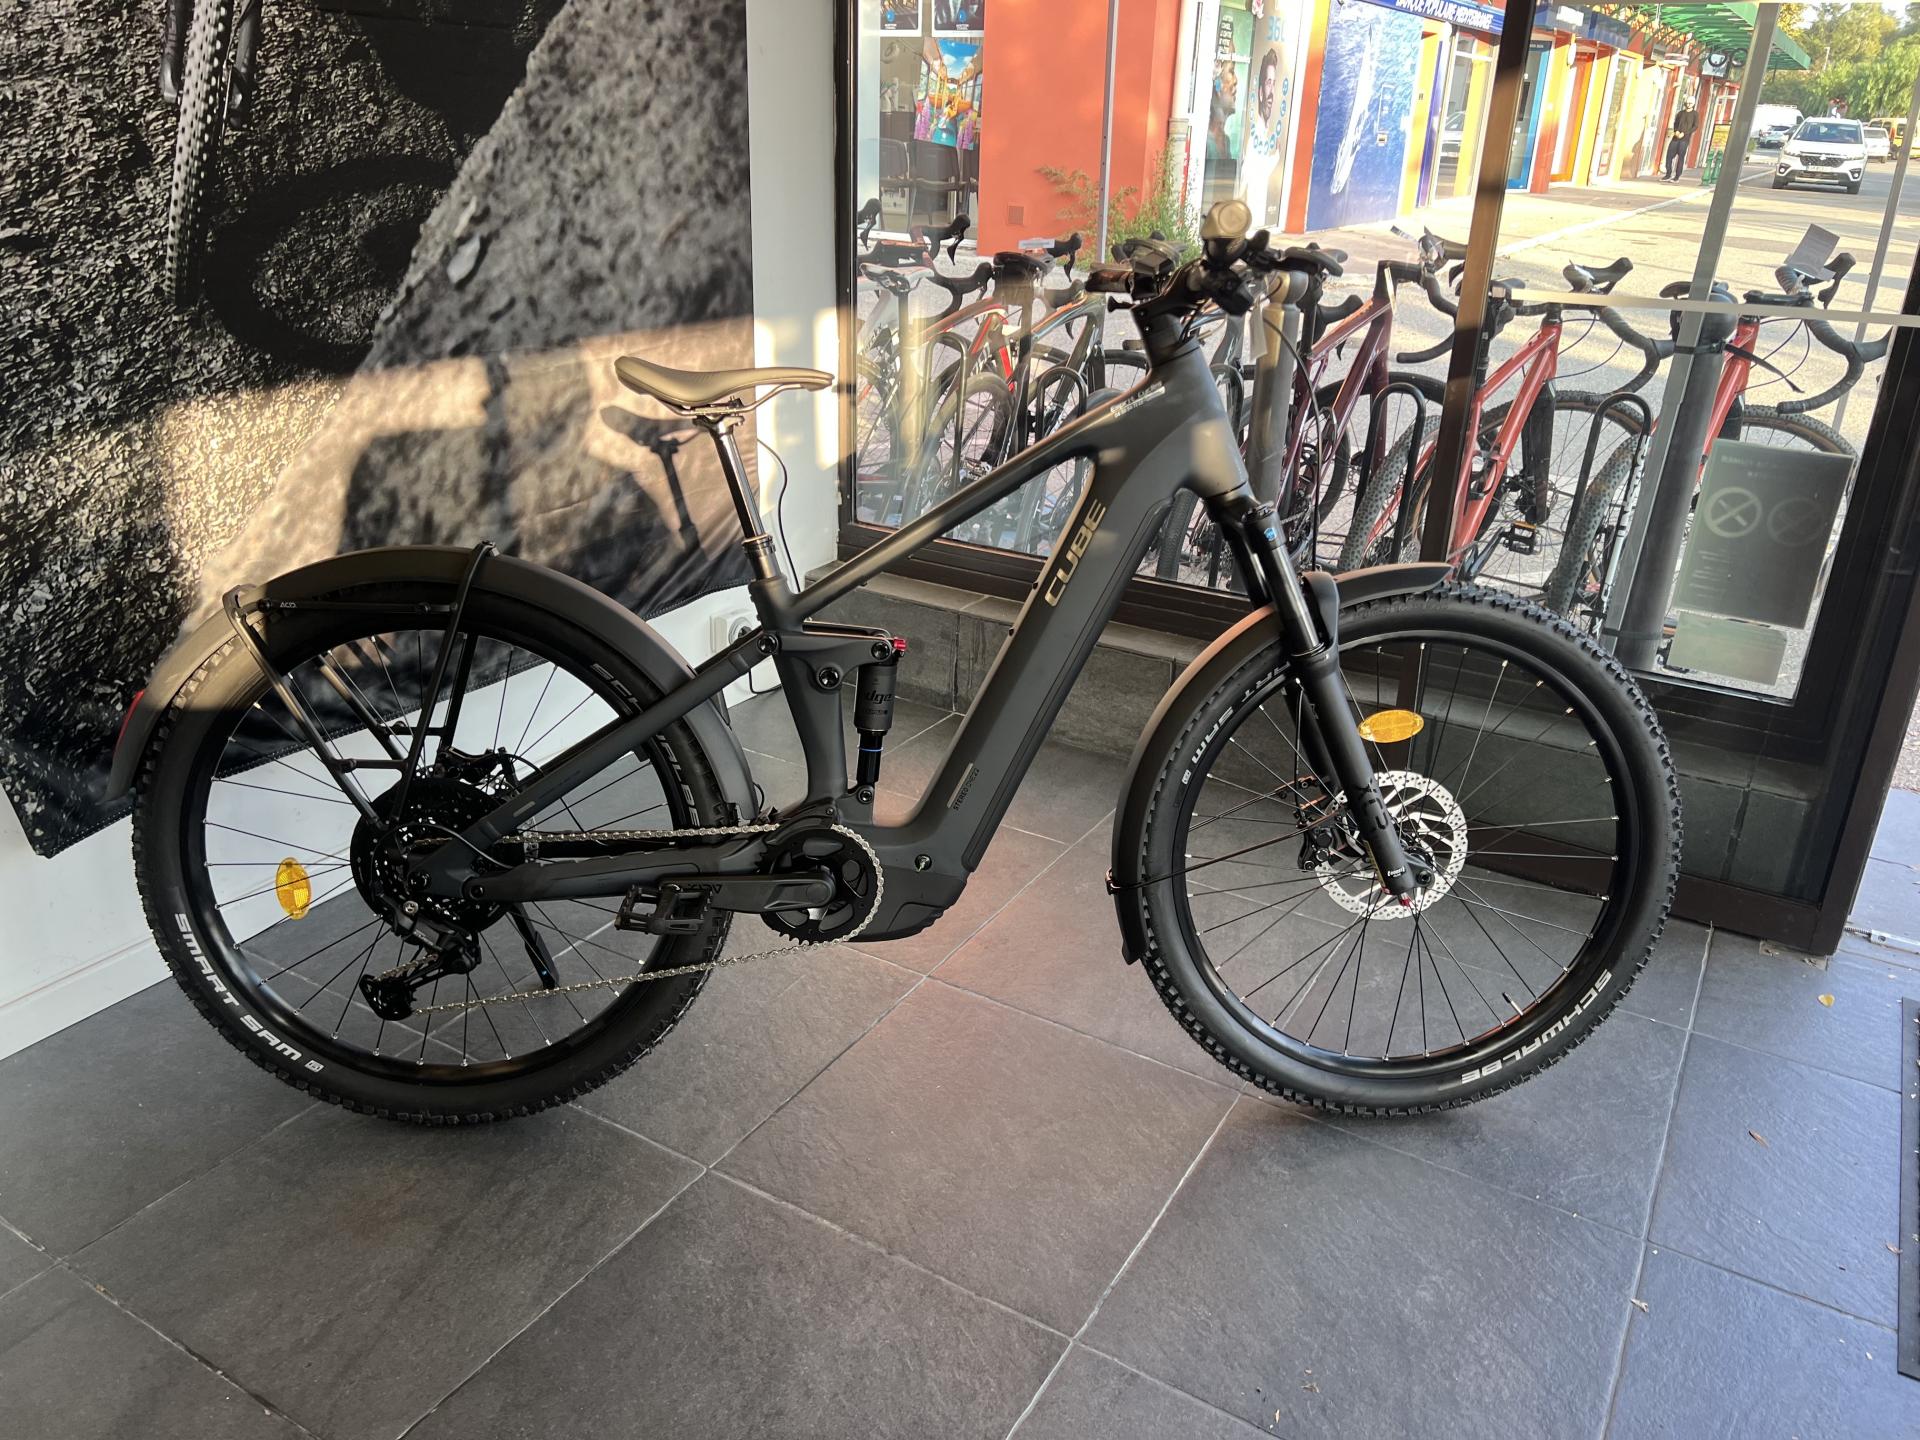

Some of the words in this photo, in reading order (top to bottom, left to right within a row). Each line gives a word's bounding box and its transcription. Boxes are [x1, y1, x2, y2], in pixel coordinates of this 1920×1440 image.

[1044, 499, 1107, 607] CUBE
[590, 663, 701, 828] SCHALBE
[174, 913, 240, 1007] SMART
[240, 1014, 303, 1061] SAM
[1461, 968, 1613, 1085] SCHWALBE
